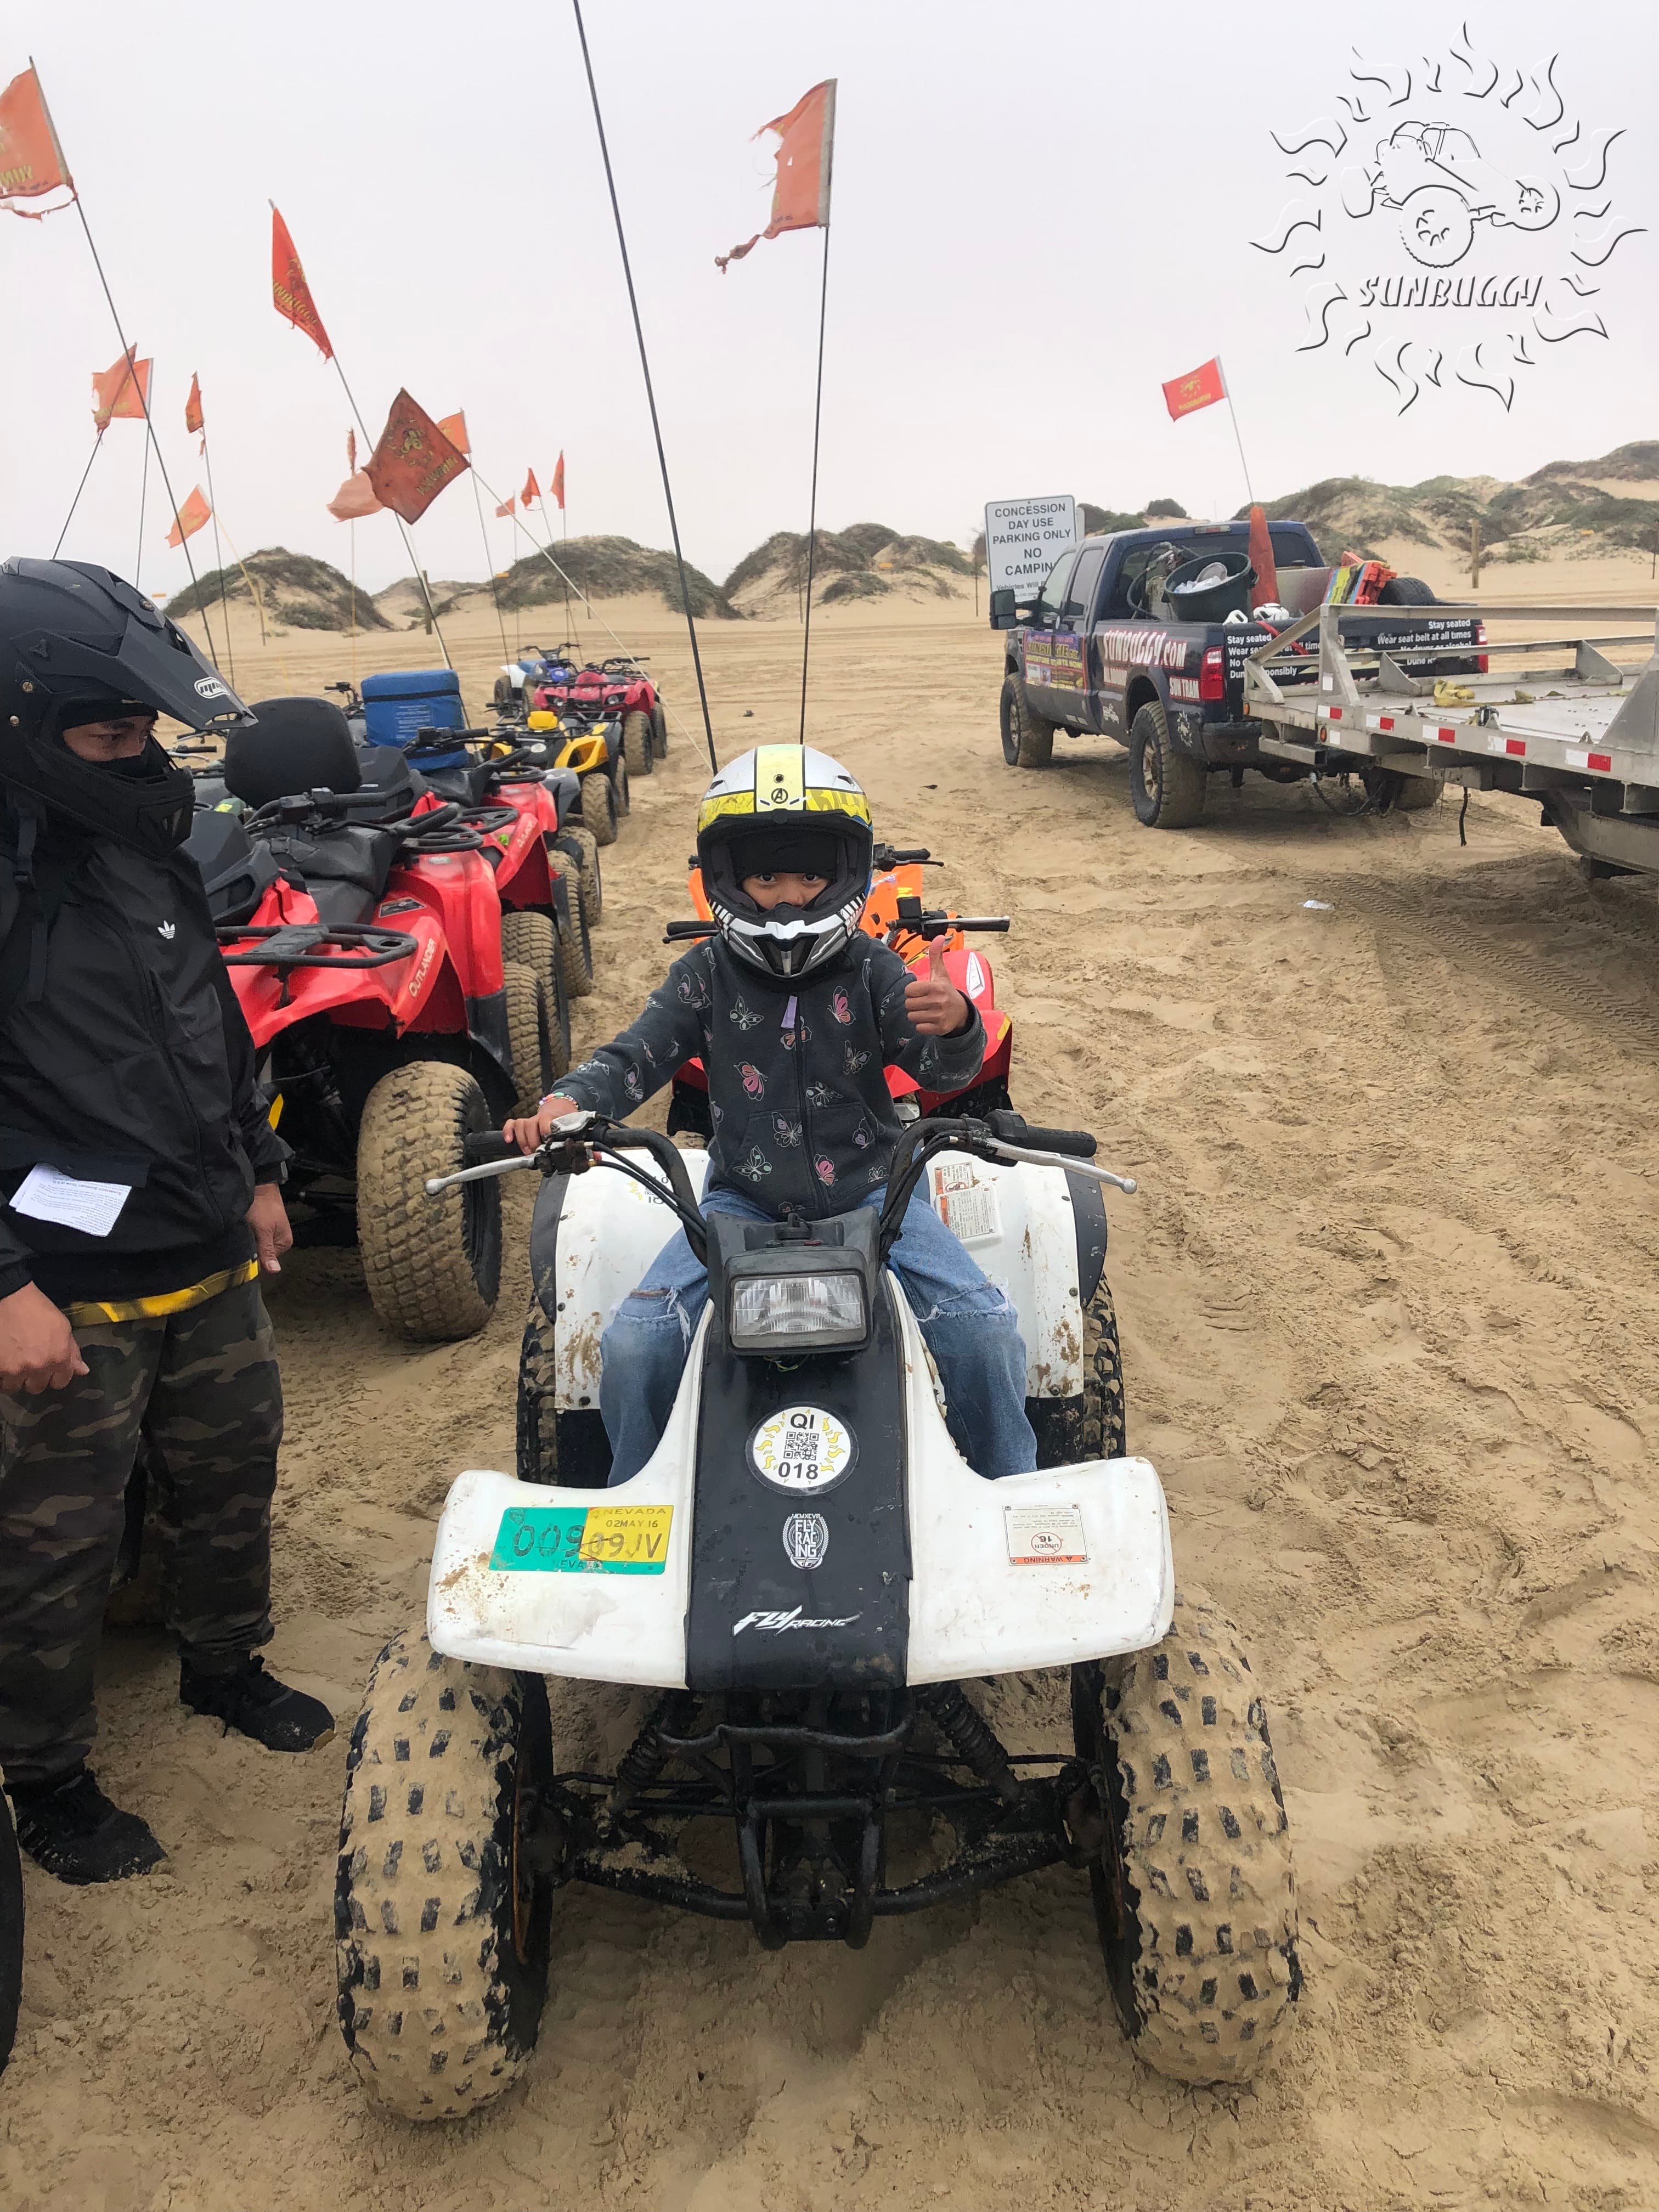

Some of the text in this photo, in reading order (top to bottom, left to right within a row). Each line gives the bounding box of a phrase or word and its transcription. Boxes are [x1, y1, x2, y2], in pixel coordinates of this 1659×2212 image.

[995, 503, 1065, 517] CONCESSION
[1008, 517, 1054, 530] DAY USE
[992, 529, 1071, 545] PARKING ONLY
[1024, 548, 1042, 558] NO
[1005, 562, 1055, 575] CAMPIN
[1429, 619, 1471, 630] Stay seated
[1227, 633, 1272, 645] Stay seated
[1378, 635, 1397, 645] Wear
[1398, 634, 1414, 643] seat
[1415, 633, 1430, 642] belt
[1441, 631, 1449, 640] all
[1451, 631, 1471, 639] times
[1228, 647, 1249, 656] Wear
[1229, 659, 1240, 667] No
[1230, 670, 1245, 679] Dun
[409, 937, 436, 997] OUTLANDER
[790, 1413, 815, 1430] QI
[778, 1462, 819, 1480] 018
[795, 1519, 816, 1532] FLY
[795, 1531, 816, 1544] RAC
[795, 1544, 817, 1558] ING
[732, 1605, 848, 1636] FLY RACING
